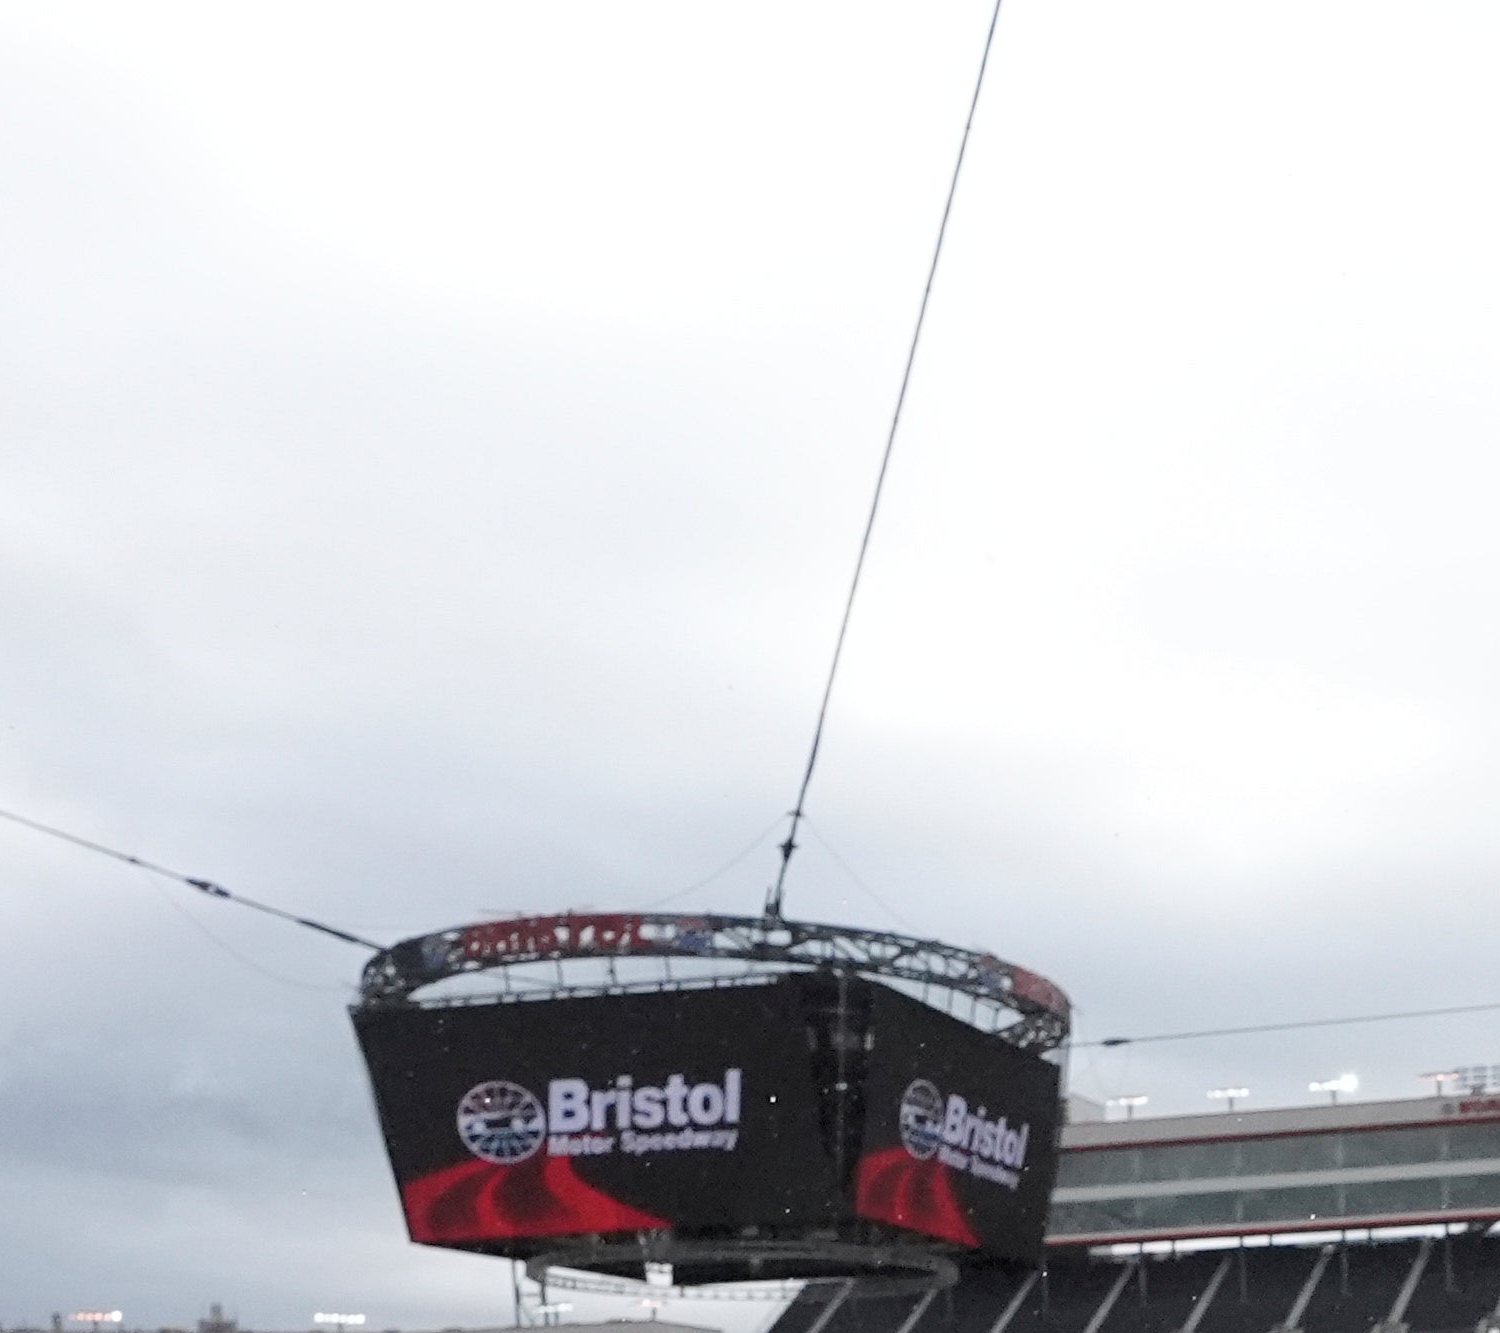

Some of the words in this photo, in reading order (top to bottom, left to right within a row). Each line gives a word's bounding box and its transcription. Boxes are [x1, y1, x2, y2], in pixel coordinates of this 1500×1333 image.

[547, 1067, 743, 1133] Bristol
[942, 1093, 1030, 1168] Bristol
[547, 1134, 616, 1156] Motor
[619, 1128, 739, 1156] Speedway
